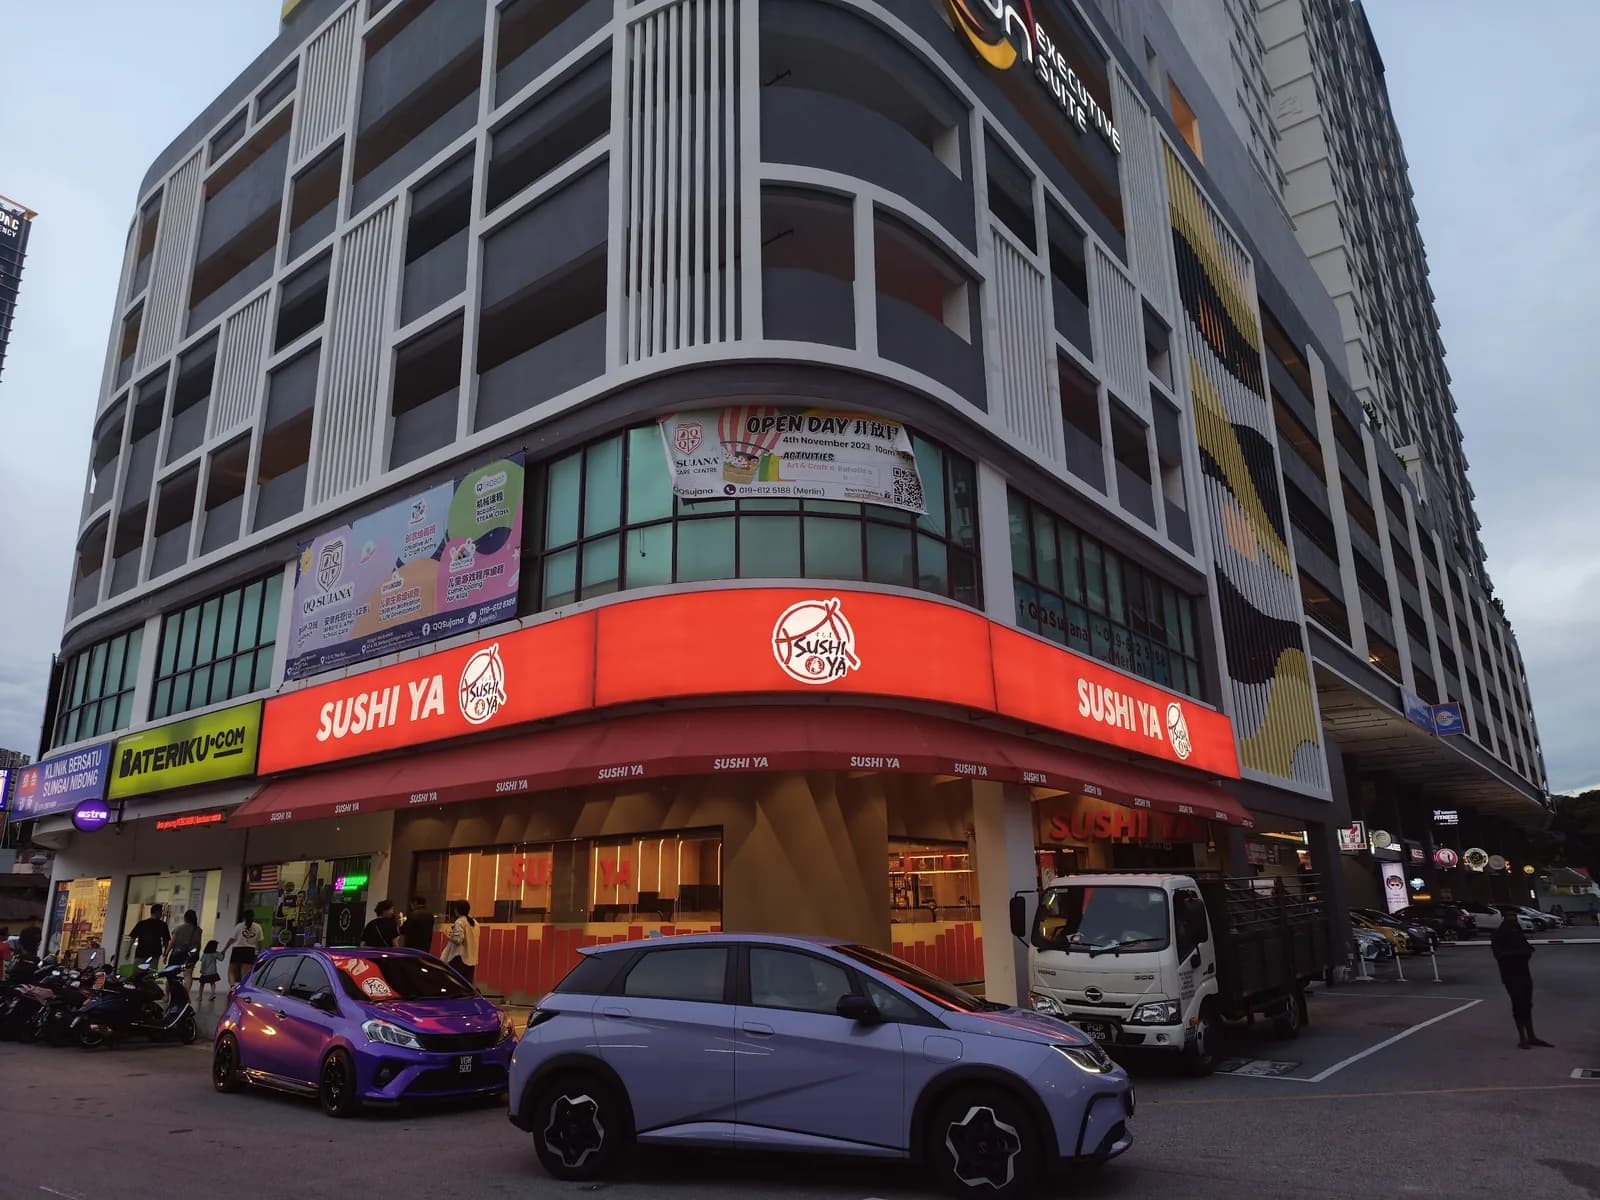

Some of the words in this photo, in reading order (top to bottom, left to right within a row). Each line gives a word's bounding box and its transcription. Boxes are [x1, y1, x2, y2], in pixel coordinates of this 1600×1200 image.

[1035, 22, 1121, 153] EXECUTIVE
[1038, 55, 1088, 134] SUITE
[746, 415, 801, 433] OPEN
[808, 416, 848, 434] DAY
[783, 436, 800, 444] 4th
[801, 437, 848, 448] November
[851, 441, 870, 450] 2023
[783, 452, 835, 461] ACTIVITIES
[793, 487, 825, 496] (Merlin)
[793, 636, 846, 658] SUSHI
[826, 656, 847, 677] YA
[469, 681, 499, 702] SUSHI
[316, 685, 400, 742] SUSHI
[408, 674, 445, 721] YA
[486, 696, 498, 716] YA
[1077, 678, 1137, 732] SUSHI
[1137, 700, 1164, 741] YA
[45, 759, 68, 779] KLINIK
[69, 750, 102, 773] BERSATU
[598, 766, 630, 779] SUSHI
[630, 764, 644, 776] YA
[714, 758, 750, 769] SUSHI
[750, 757, 769, 768] YA
[850, 756, 884, 768] SUSHI
[883, 758, 900, 768] YA
[954, 762, 977, 776] SUSHI
[977, 764, 988, 776] YA
[43, 778, 68, 797] SUNGAI
[70, 769, 99, 791] NIBONG
[496, 781, 516, 792] SUSHI
[516, 779, 528, 790] YA
[1024, 772, 1039, 783] SUSHI
[410, 794, 427, 803] SUSHI
[1050, 810, 1148, 841] SUSHI
